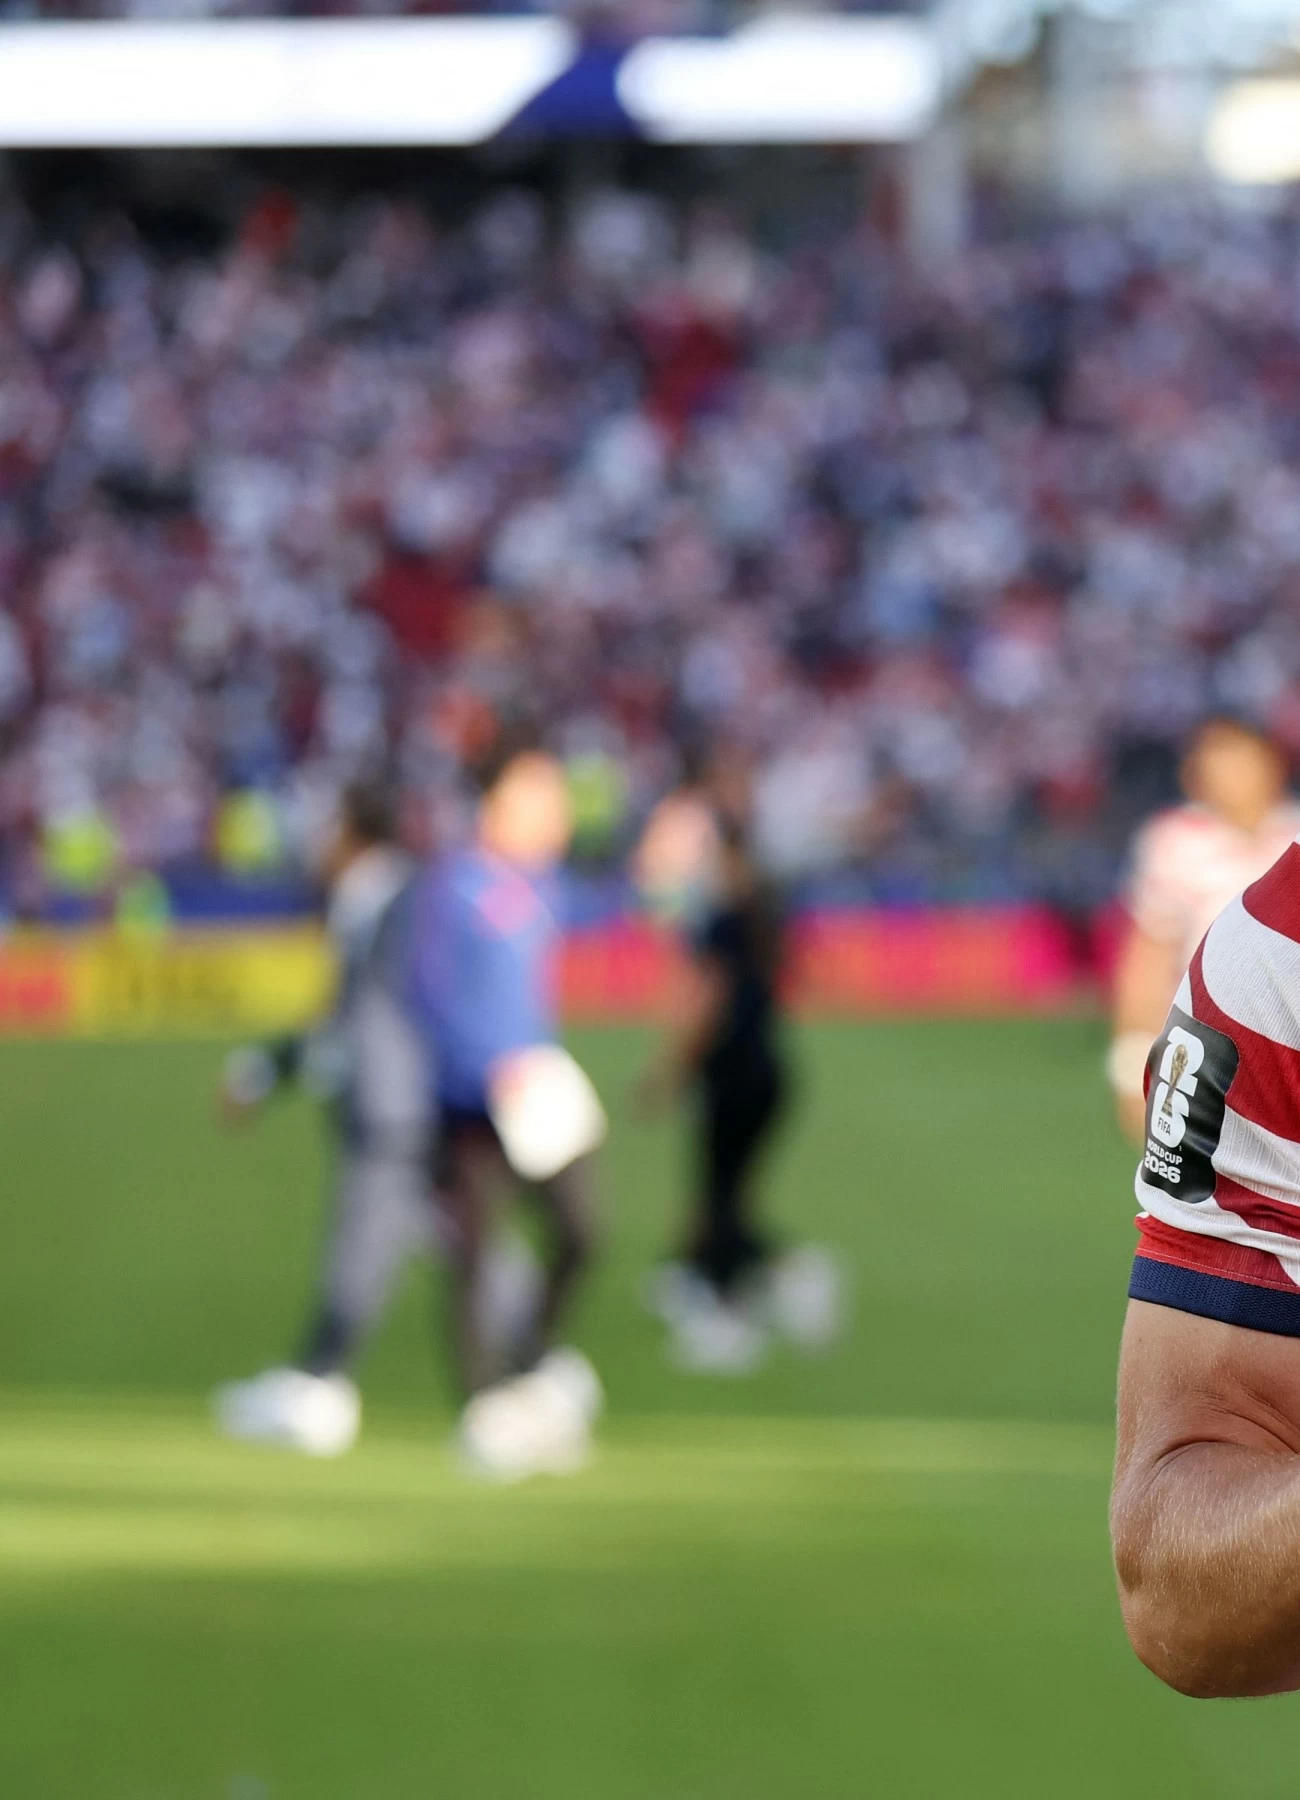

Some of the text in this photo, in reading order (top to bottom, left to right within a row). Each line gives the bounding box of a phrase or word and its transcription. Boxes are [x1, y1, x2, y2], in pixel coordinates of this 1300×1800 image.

[1157, 1116, 1171, 1136] FIFA
[1144, 1150, 1181, 1184] 2026
[1164, 1151, 1183, 1165] CUP
